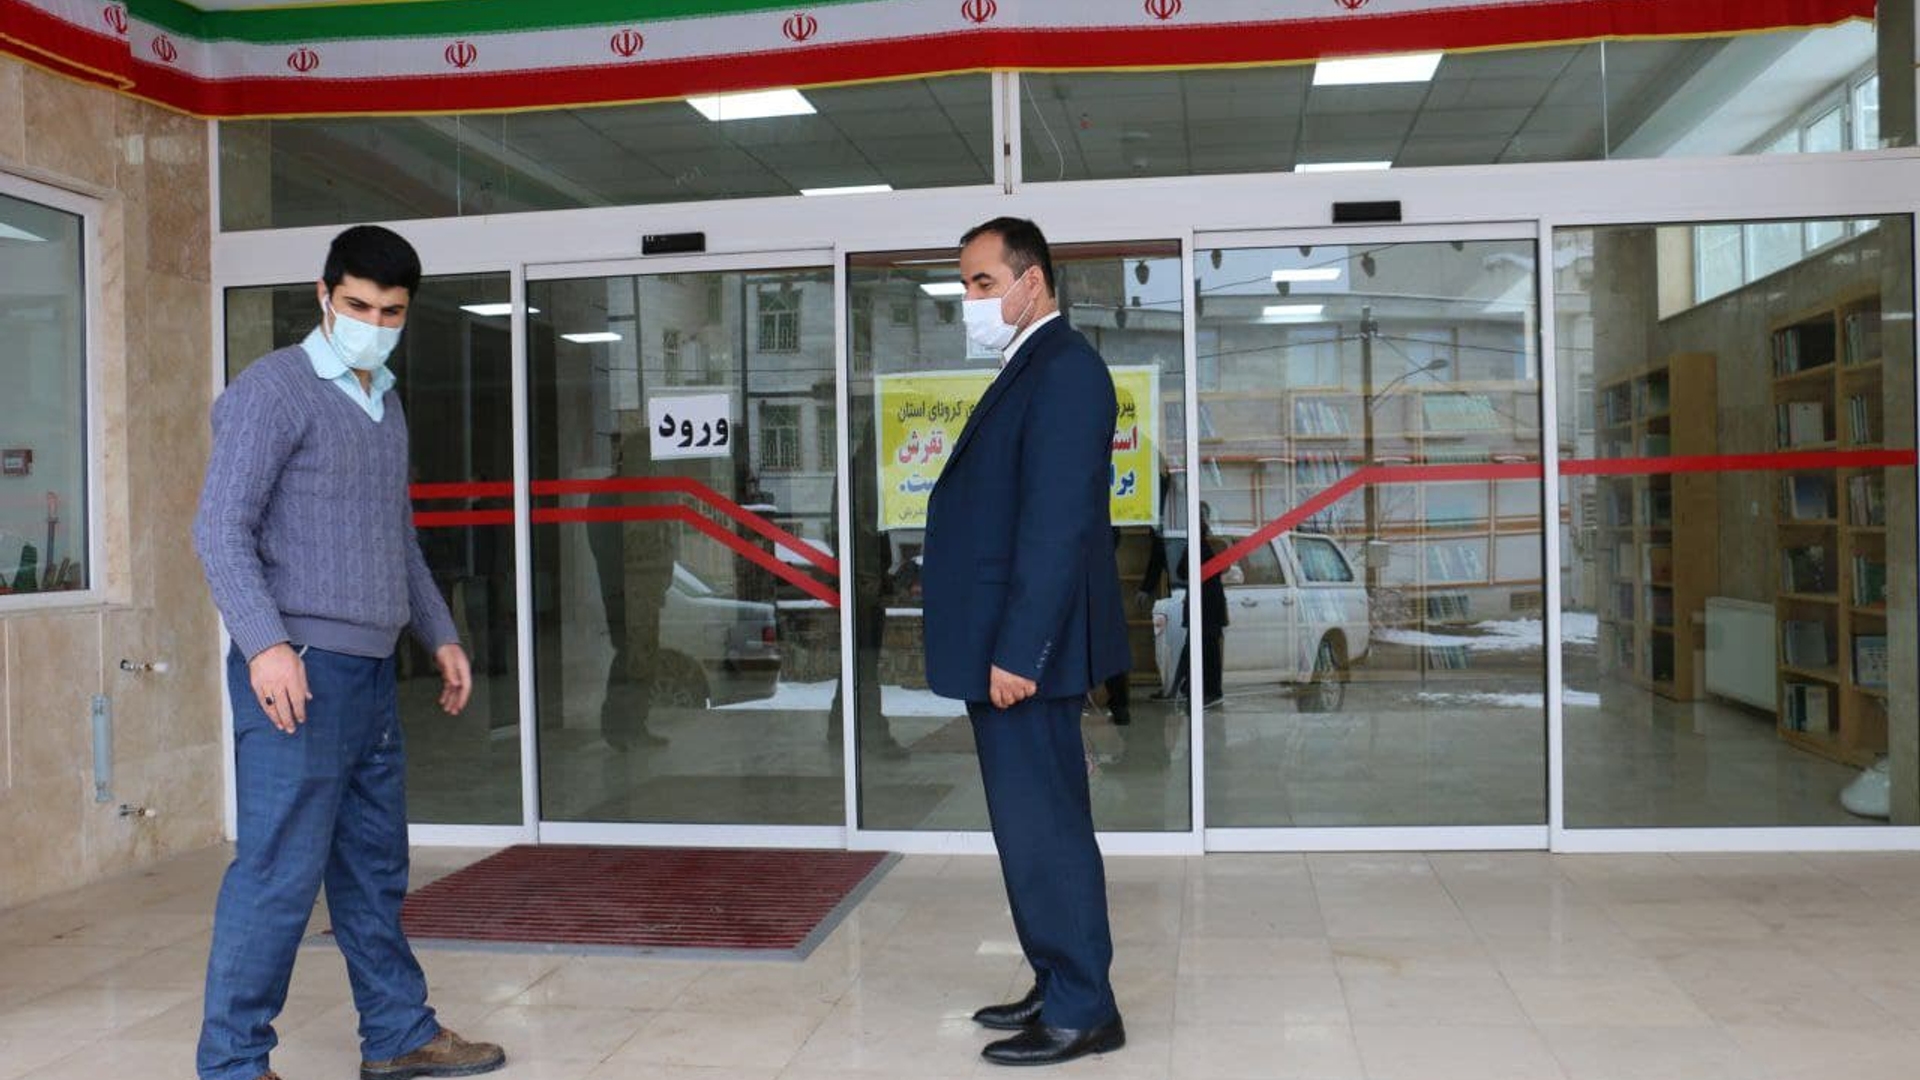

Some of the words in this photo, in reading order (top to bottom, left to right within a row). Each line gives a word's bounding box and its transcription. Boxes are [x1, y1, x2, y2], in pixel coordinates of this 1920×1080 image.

[898, 400, 926, 422] استان
[928, 399, 963, 422] کرونای
[658, 412, 729, 448] ورود
[899, 430, 943, 463] تفرش
